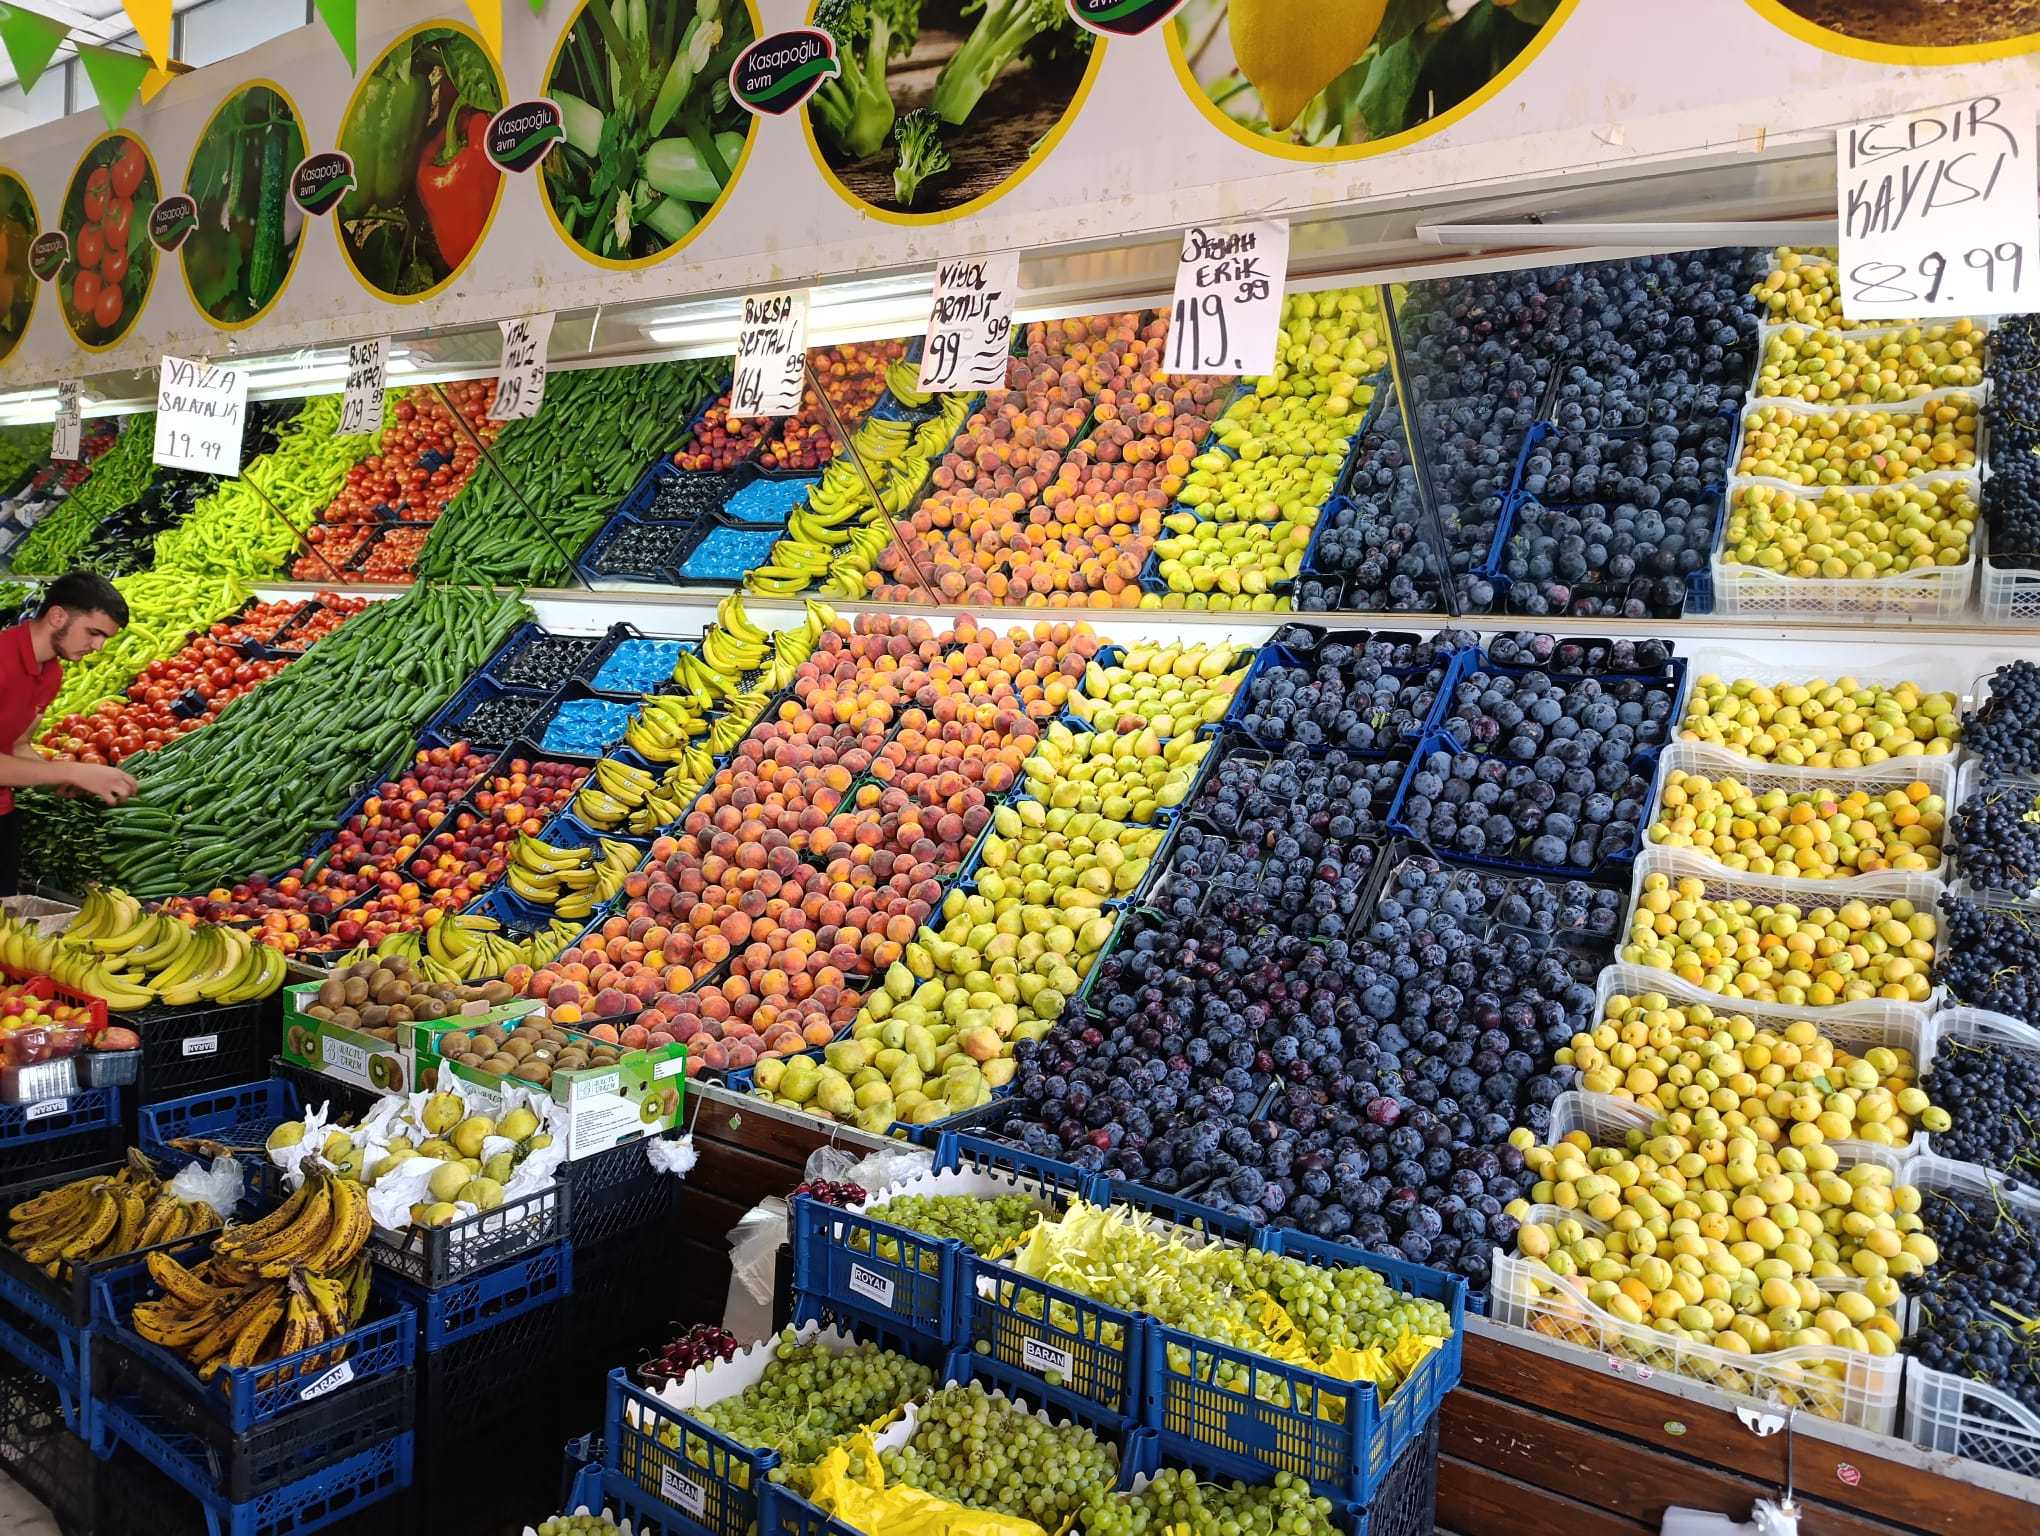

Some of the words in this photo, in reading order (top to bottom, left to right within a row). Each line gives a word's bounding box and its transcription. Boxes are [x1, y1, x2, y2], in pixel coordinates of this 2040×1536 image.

[748, 40, 820, 72] Kasapoğlu
[746, 74, 772, 91] avm
[498, 110, 551, 135] Kasapoğlu
[496, 138, 515, 152] avm
[301, 162, 345, 182] Kasapoğlu
[300, 185, 316, 197] avm
[1846, 152, 2006, 239] KAYISI
[156, 202, 190, 223] Kasapoğlu
[1234, 280, 1270, 303] 99
[745, 295, 792, 324] BURSA
[930, 291, 1002, 324] ARMUT
[985, 315, 1011, 344] 99
[349, 342, 379, 367] BURSA
[785, 353, 806, 373] 99
[169, 360, 236, 393] YAYLA
[855, 1269, 887, 1292] ROYAL
[1027, 1343, 1065, 1367] BARAN
[665, 1471, 698, 1501] BARAN
